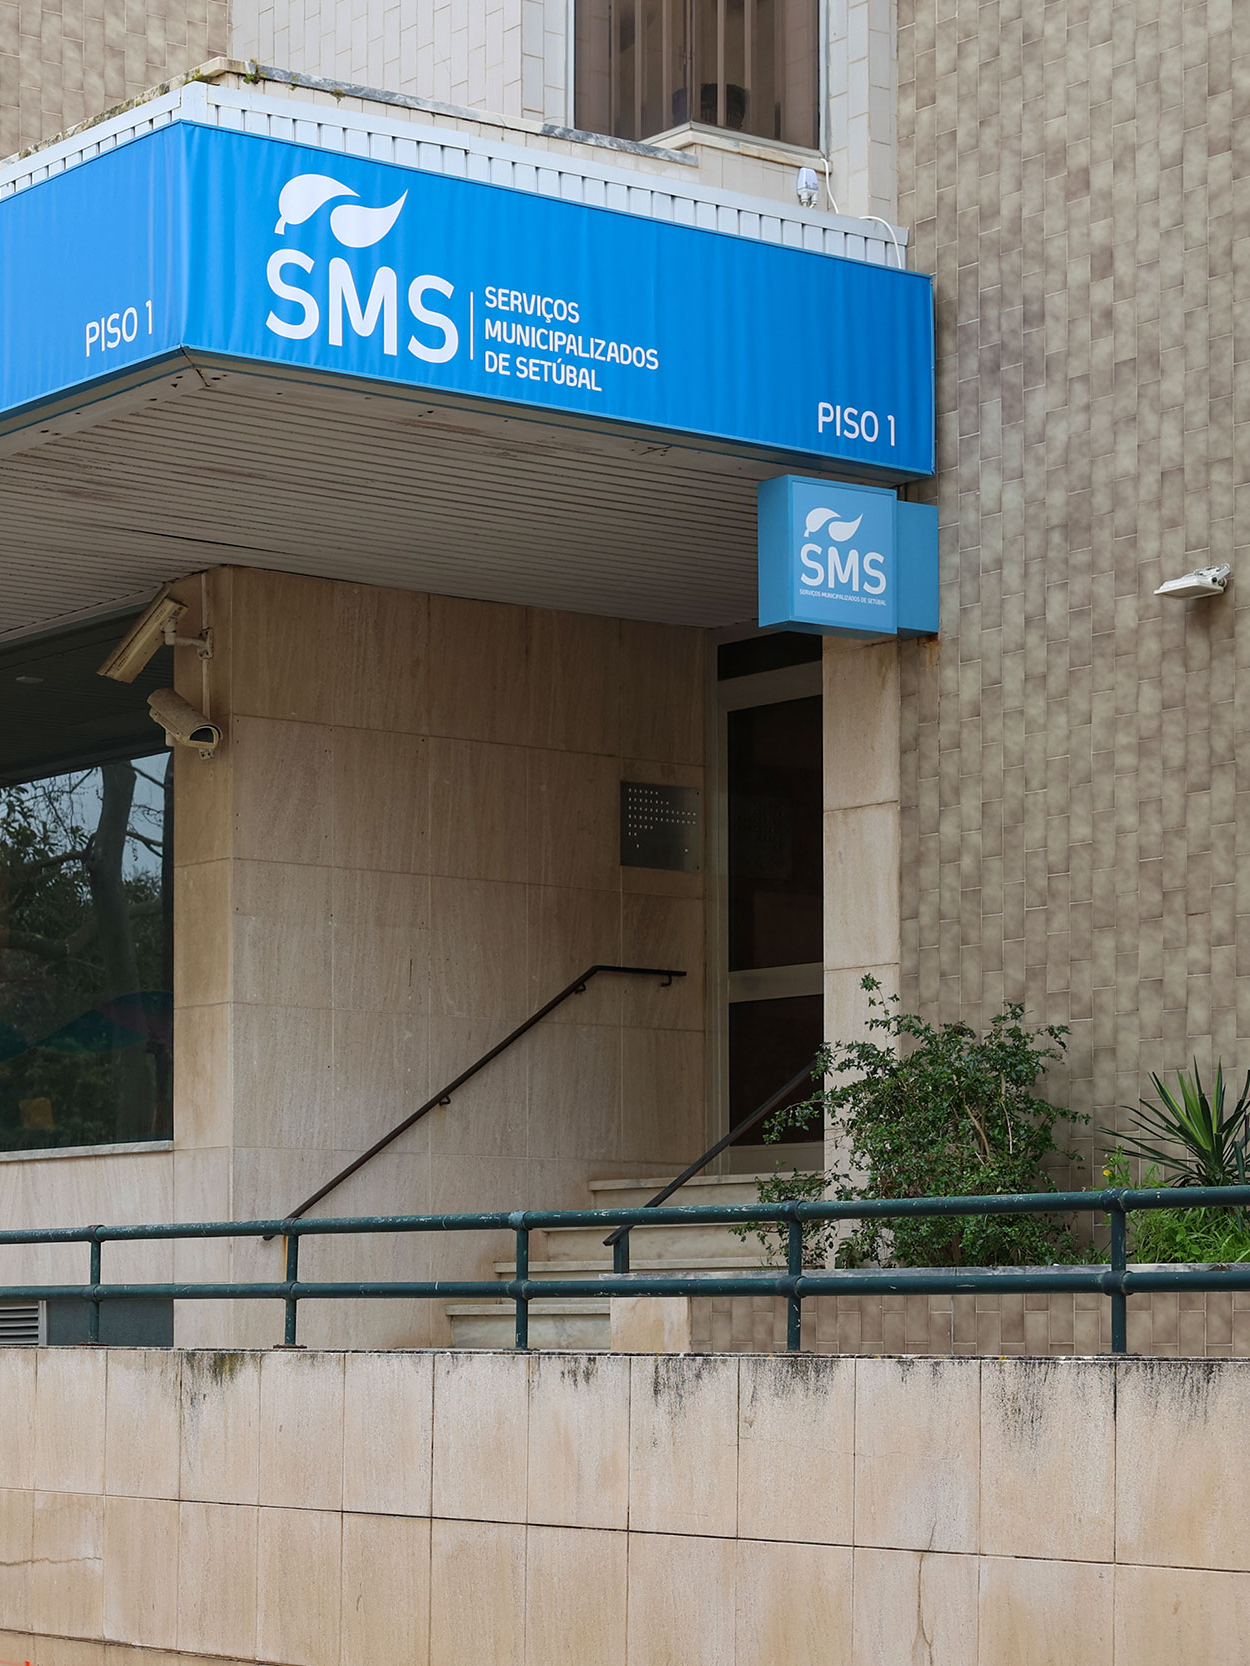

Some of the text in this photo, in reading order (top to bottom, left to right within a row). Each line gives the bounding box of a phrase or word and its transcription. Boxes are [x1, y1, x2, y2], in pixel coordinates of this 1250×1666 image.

[86, 299, 153, 357] PISO 1
[266, 248, 459, 364] SMS
[485, 286, 580, 324] SERVIÇOS
[485, 318, 659, 370] MUNICIPALIZADOS
[485, 350, 602, 392] DE SETÚBAL
[818, 401, 895, 447] PISO 1
[800, 542, 887, 595] SMS
[799, 588, 822, 598] SERVIÇOS
[821, 591, 861, 603] MUNICIPALIZADOS
